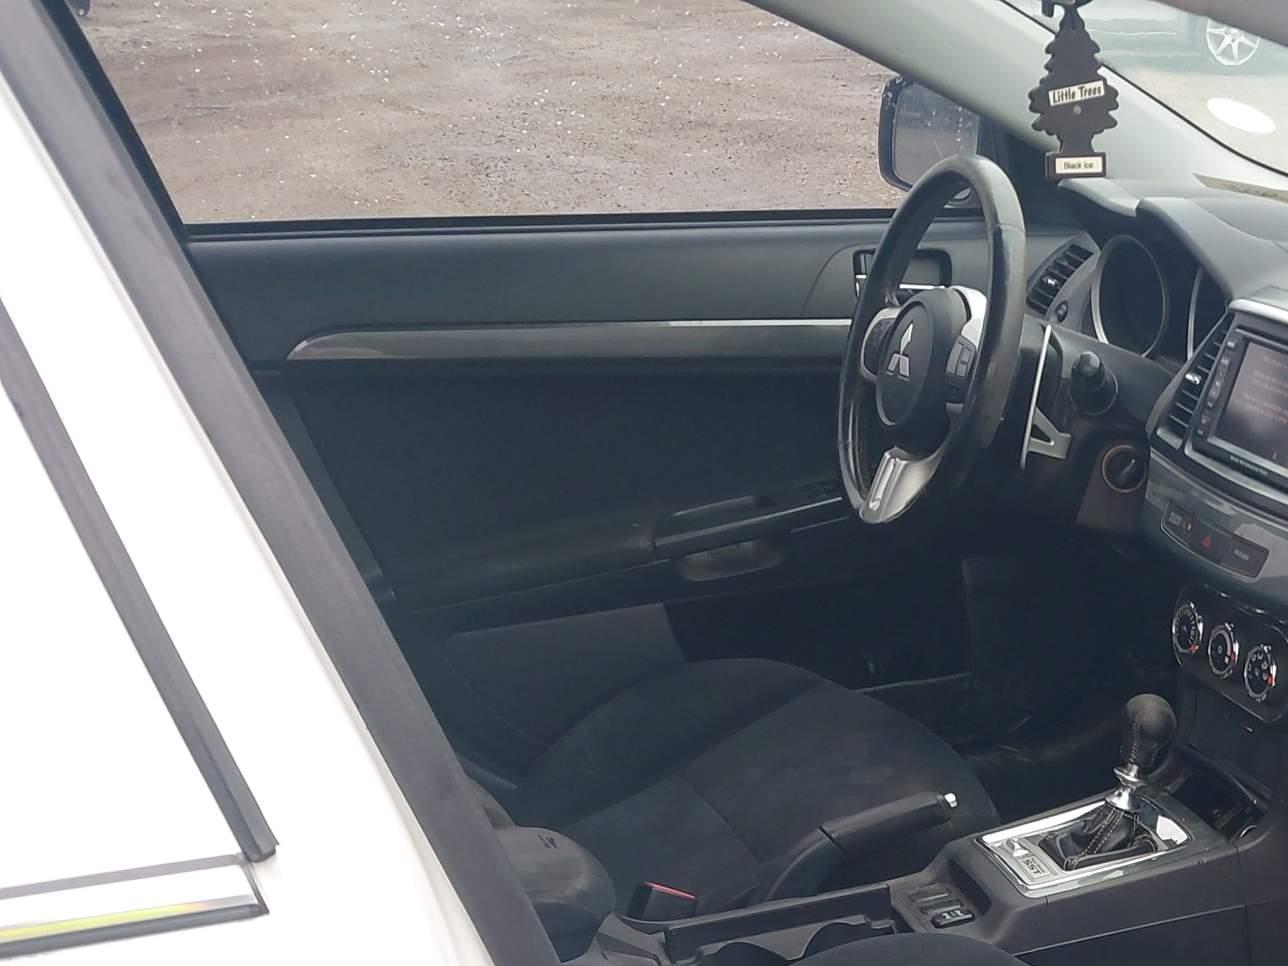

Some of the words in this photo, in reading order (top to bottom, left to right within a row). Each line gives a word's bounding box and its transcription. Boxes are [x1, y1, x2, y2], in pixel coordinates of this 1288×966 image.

[1052, 86, 1076, 103] Little
[1078, 84, 1102, 98] Trees
[1063, 161, 1082, 170] Black
[1083, 161, 1094, 169] Ice
